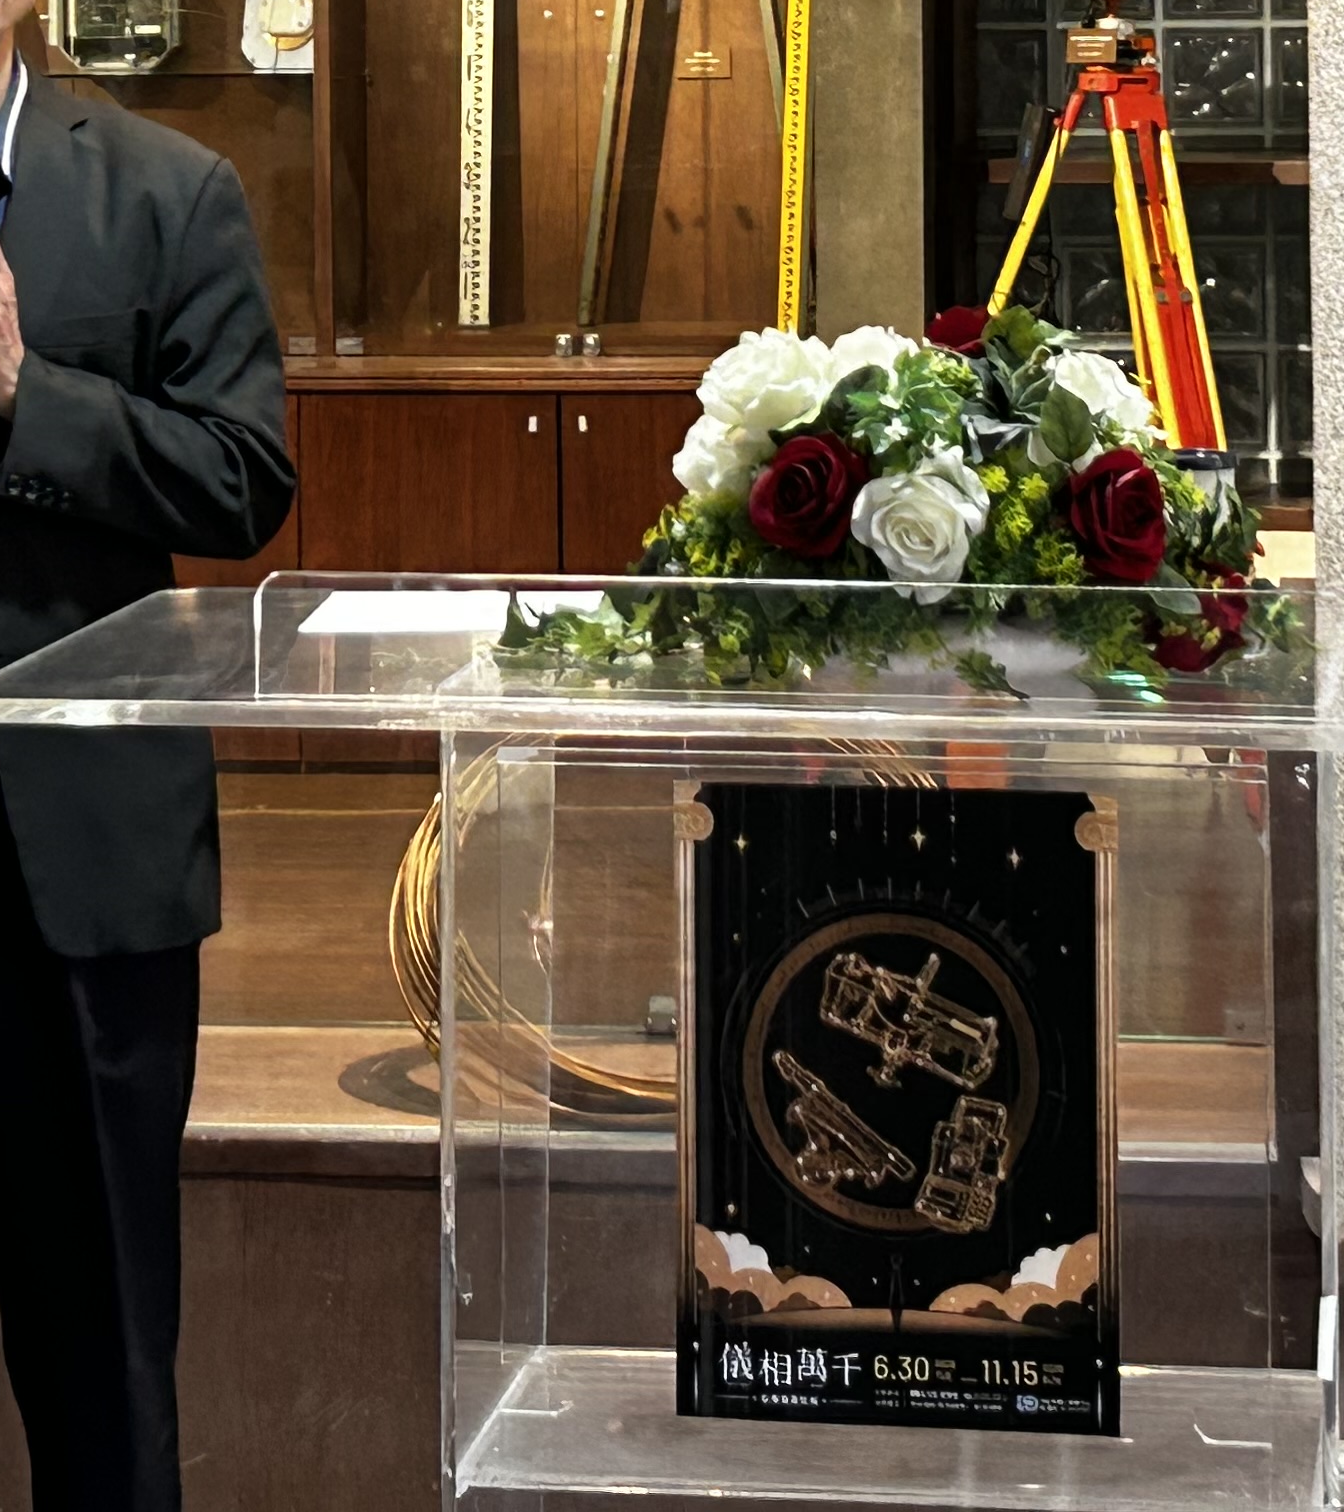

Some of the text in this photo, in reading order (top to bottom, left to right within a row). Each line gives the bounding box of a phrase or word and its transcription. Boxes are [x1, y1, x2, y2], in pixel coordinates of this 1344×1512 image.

[719, 1341, 862, 1387] 儀相萬千
[873, 1354, 930, 1382] 6.30
[982, 1359, 1039, 1386] 11.15
